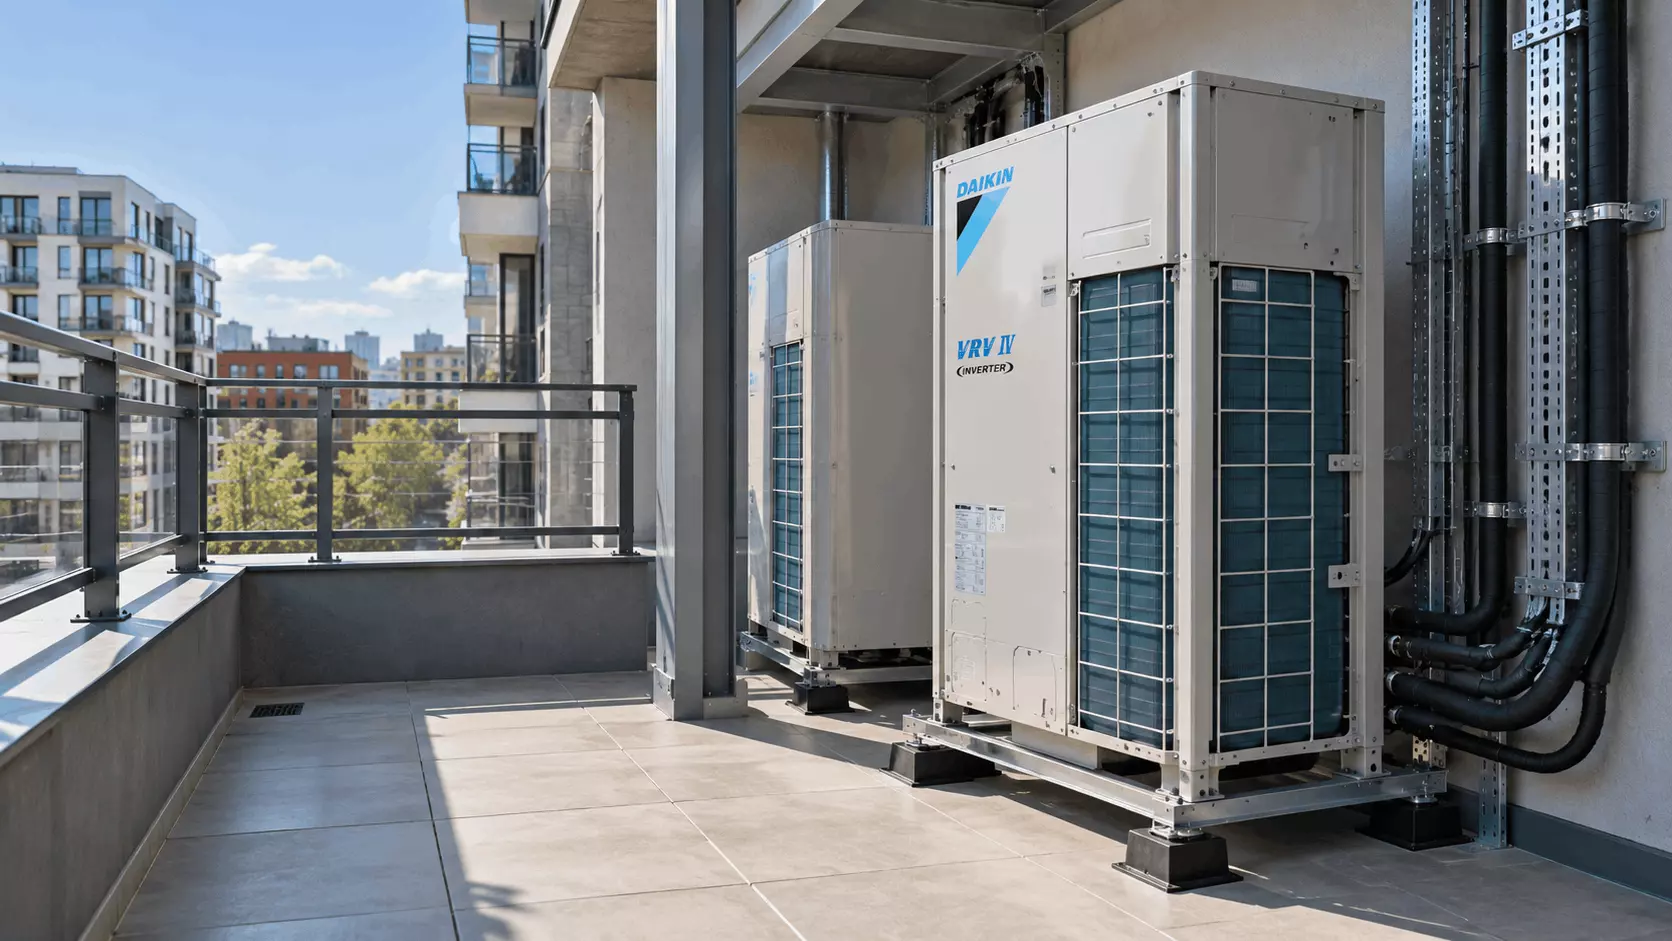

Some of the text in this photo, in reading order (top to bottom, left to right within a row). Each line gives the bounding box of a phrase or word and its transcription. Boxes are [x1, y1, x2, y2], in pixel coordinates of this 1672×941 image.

[957, 166, 1014, 198] DAIKIN
[958, 333, 1016, 360] VRV IV
